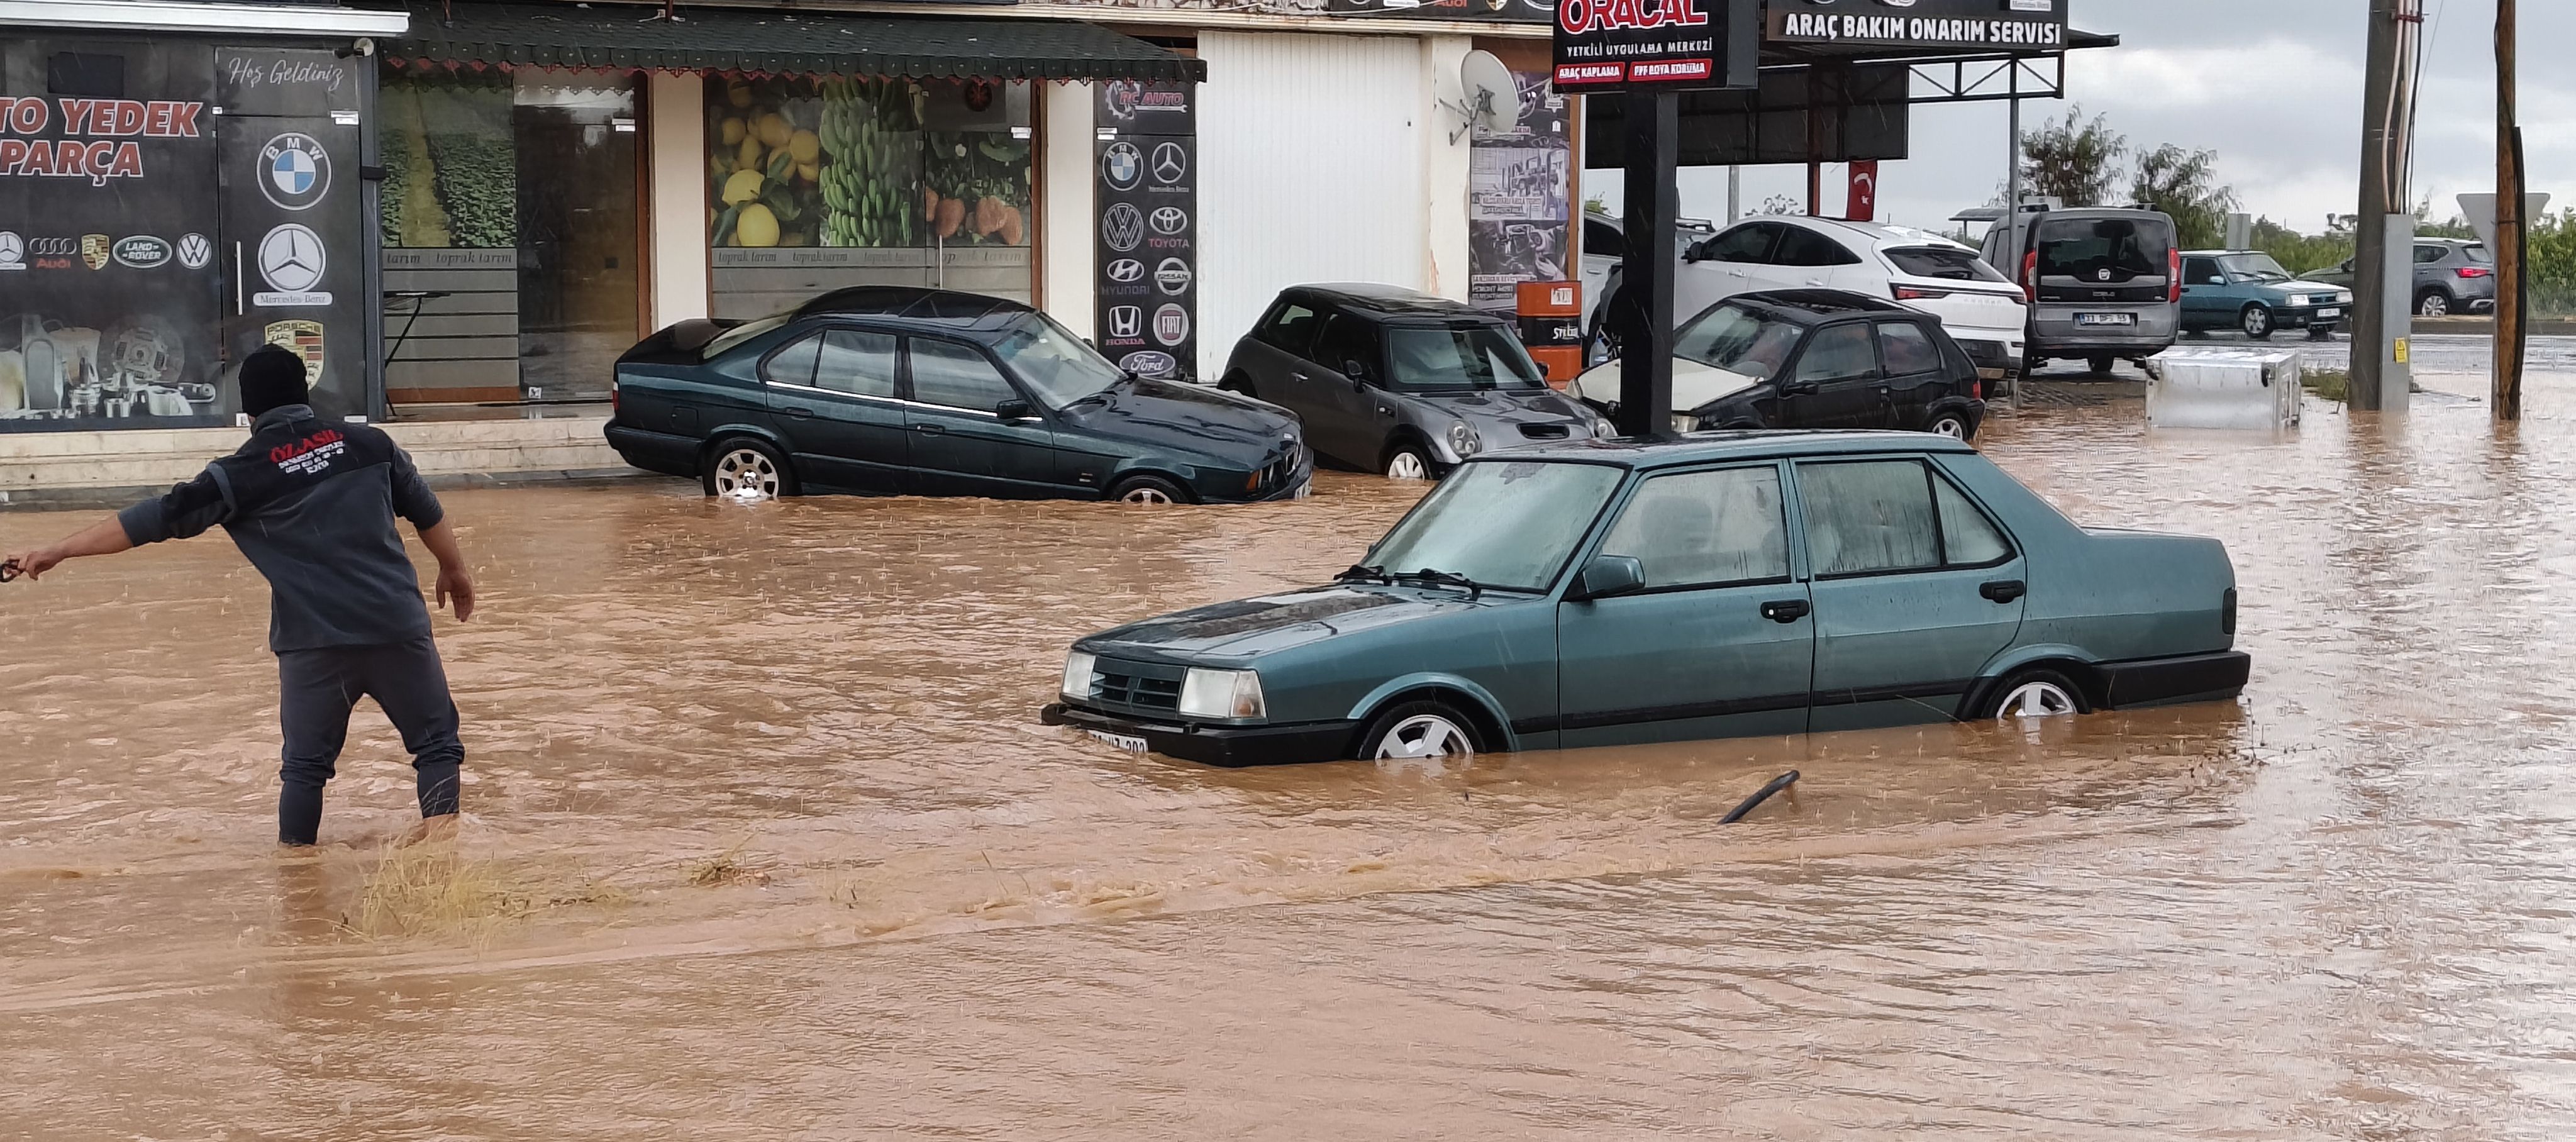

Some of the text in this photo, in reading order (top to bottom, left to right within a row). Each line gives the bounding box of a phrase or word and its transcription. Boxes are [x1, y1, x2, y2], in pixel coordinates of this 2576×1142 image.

[1560, 0, 1709, 35] ORACAL
[1785, 13, 1838, 40] ARAÇ
[1843, 15, 1905, 39] BAKIM
[1910, 18, 1985, 42] ONARIM
[1567, 36, 1713, 58] YETKİLİ UYGULAMA MERKEZİ
[229, 57, 344, 92] Hoş Geldiniz
[1581, 65, 1620, 78] KAPLAMA
[1141, 92, 1184, 106] AUTO
[59, 98, 203, 137] YEDEK
[265, 137, 323, 160] BMW
[0, 139, 144, 187] PARÇA
[1148, 238, 1190, 248] TOYOTA
[1102, 286, 1150, 295] HYUNDAI
[267, 323, 321, 335] PORSCHE
[1162, 316, 1181, 334] FIAT
[1106, 338, 1146, 346] HONDA
[1130, 353, 1164, 372] Ford
